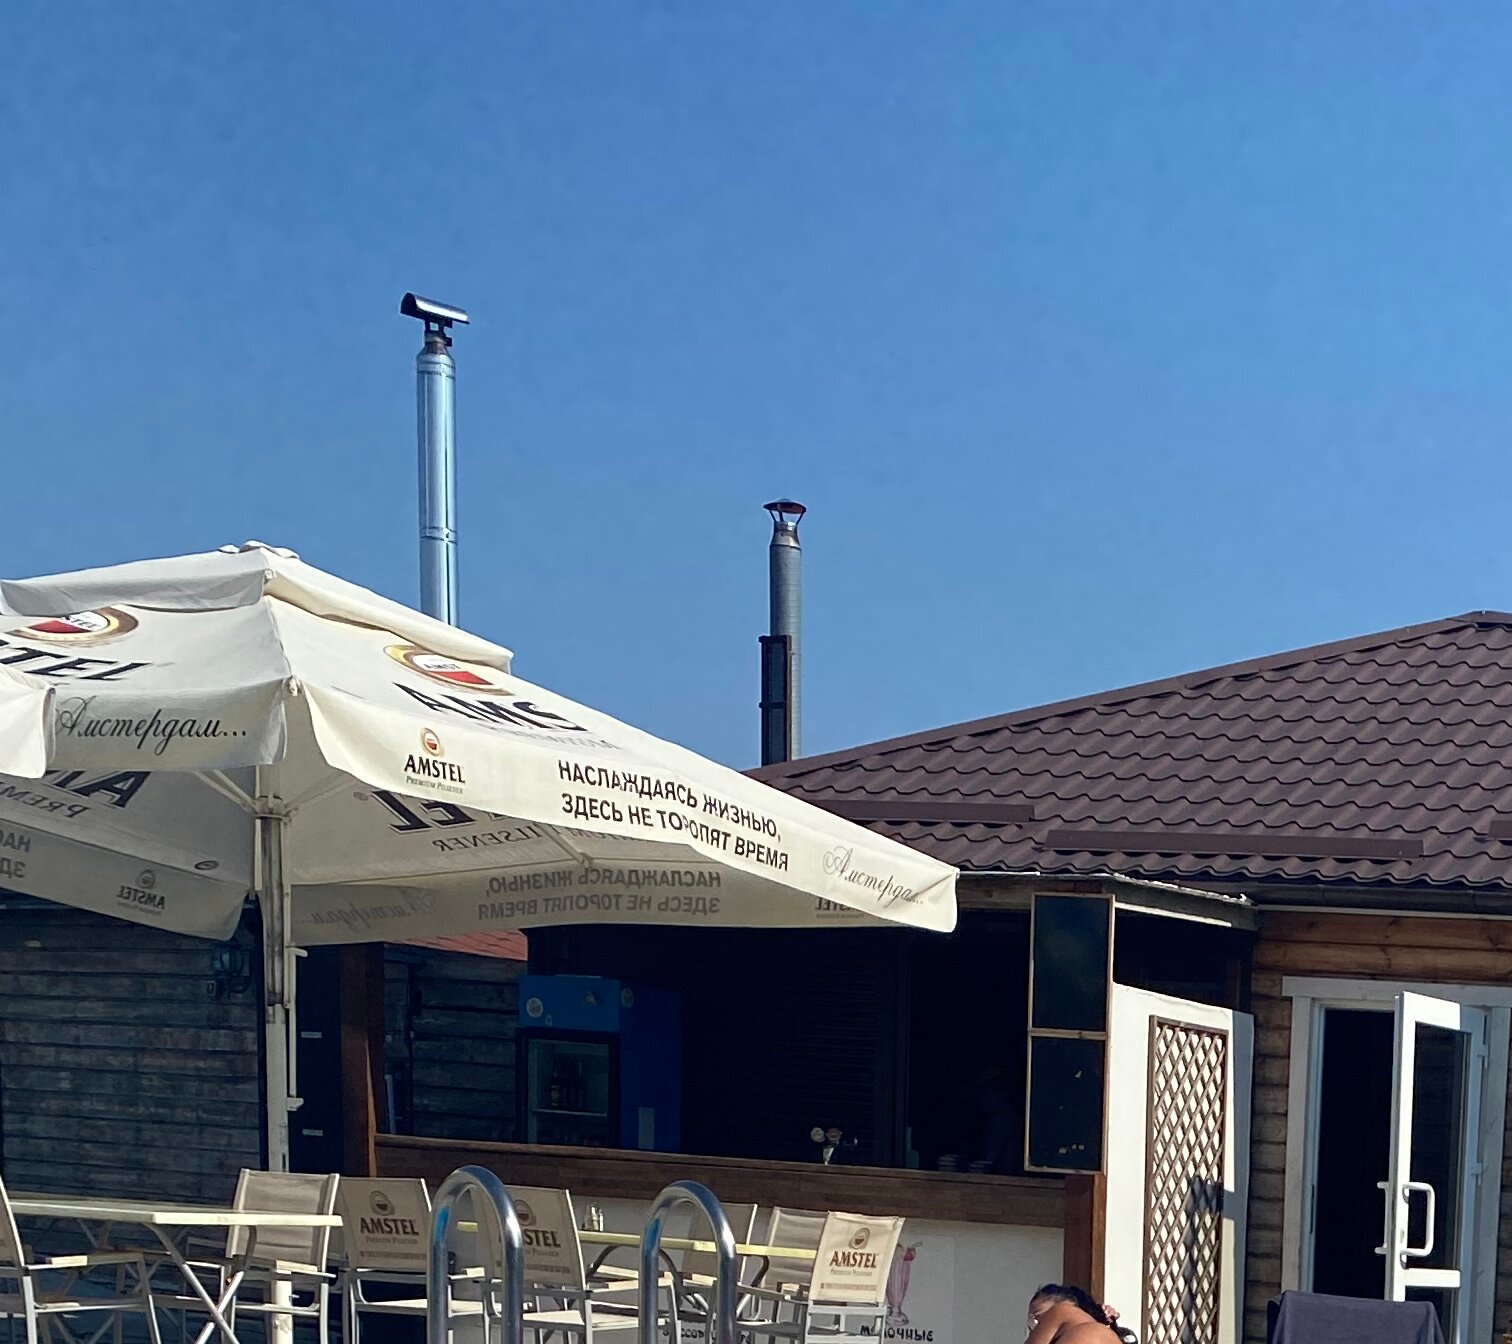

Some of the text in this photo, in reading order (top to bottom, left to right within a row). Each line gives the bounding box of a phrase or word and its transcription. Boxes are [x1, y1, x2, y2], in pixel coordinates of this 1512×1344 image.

[0, 639, 152, 681] TEL
[403, 754, 466, 784] AMSTEL
[558, 760, 782, 843] НАСЛАЖДАЯСЬ ЖИЗНЬЮ,
[561, 793, 623, 822] ЗДЕСЬ
[628, 804, 654, 827] НЕ
[735, 836, 789, 872] ВРЕМЯ
[360, 1216, 420, 1236] AMSTEL
[829, 1250, 877, 1269] AMSTEL
